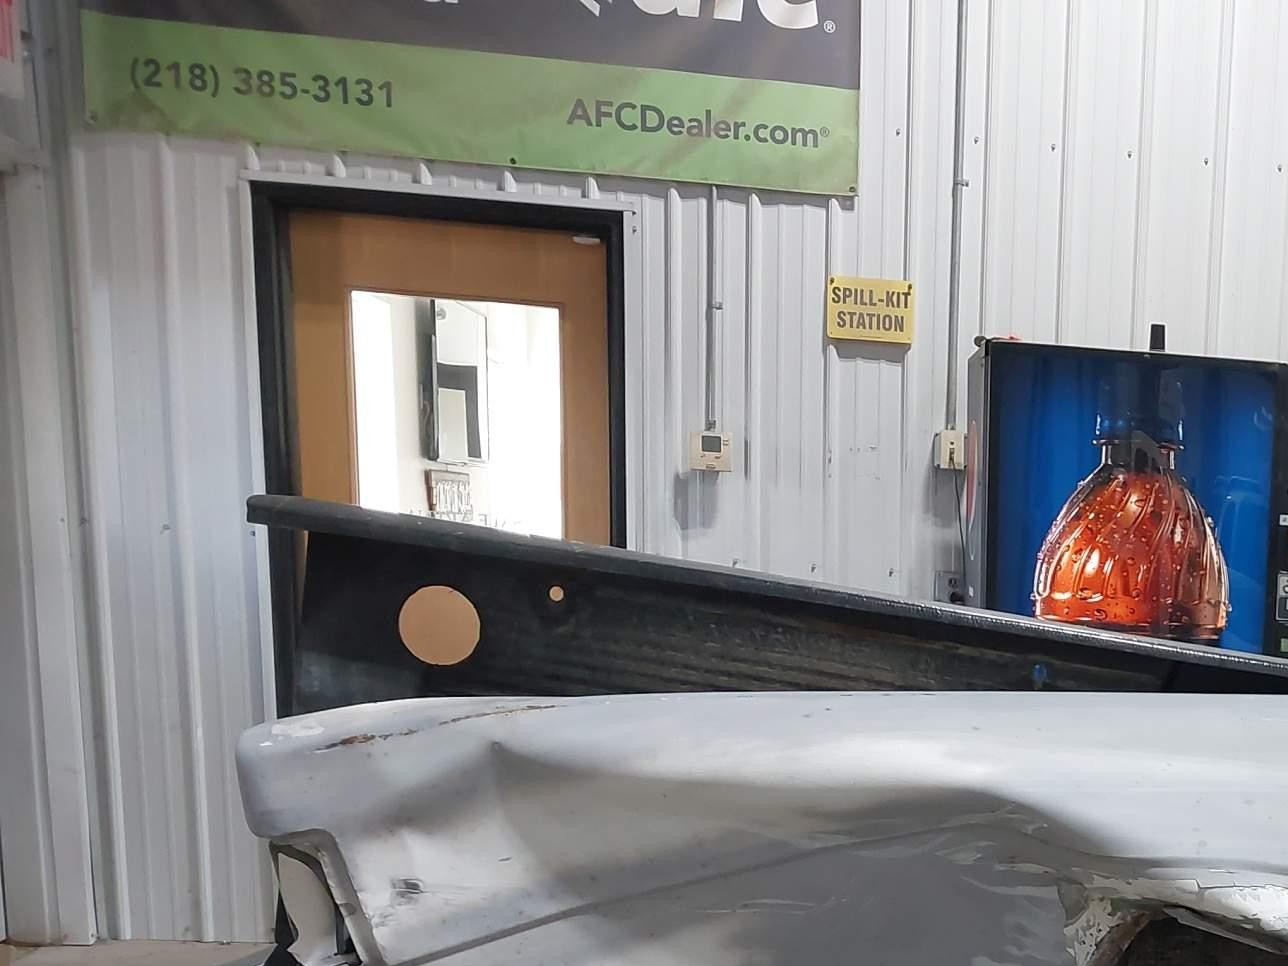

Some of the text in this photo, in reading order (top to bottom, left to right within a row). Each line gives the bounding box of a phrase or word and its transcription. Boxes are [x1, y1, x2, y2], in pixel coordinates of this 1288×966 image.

[130, 57, 393, 108] (218) 385-3131
[831, 286, 911, 309] SPILL-KIT
[836, 310, 904, 333] STATION
